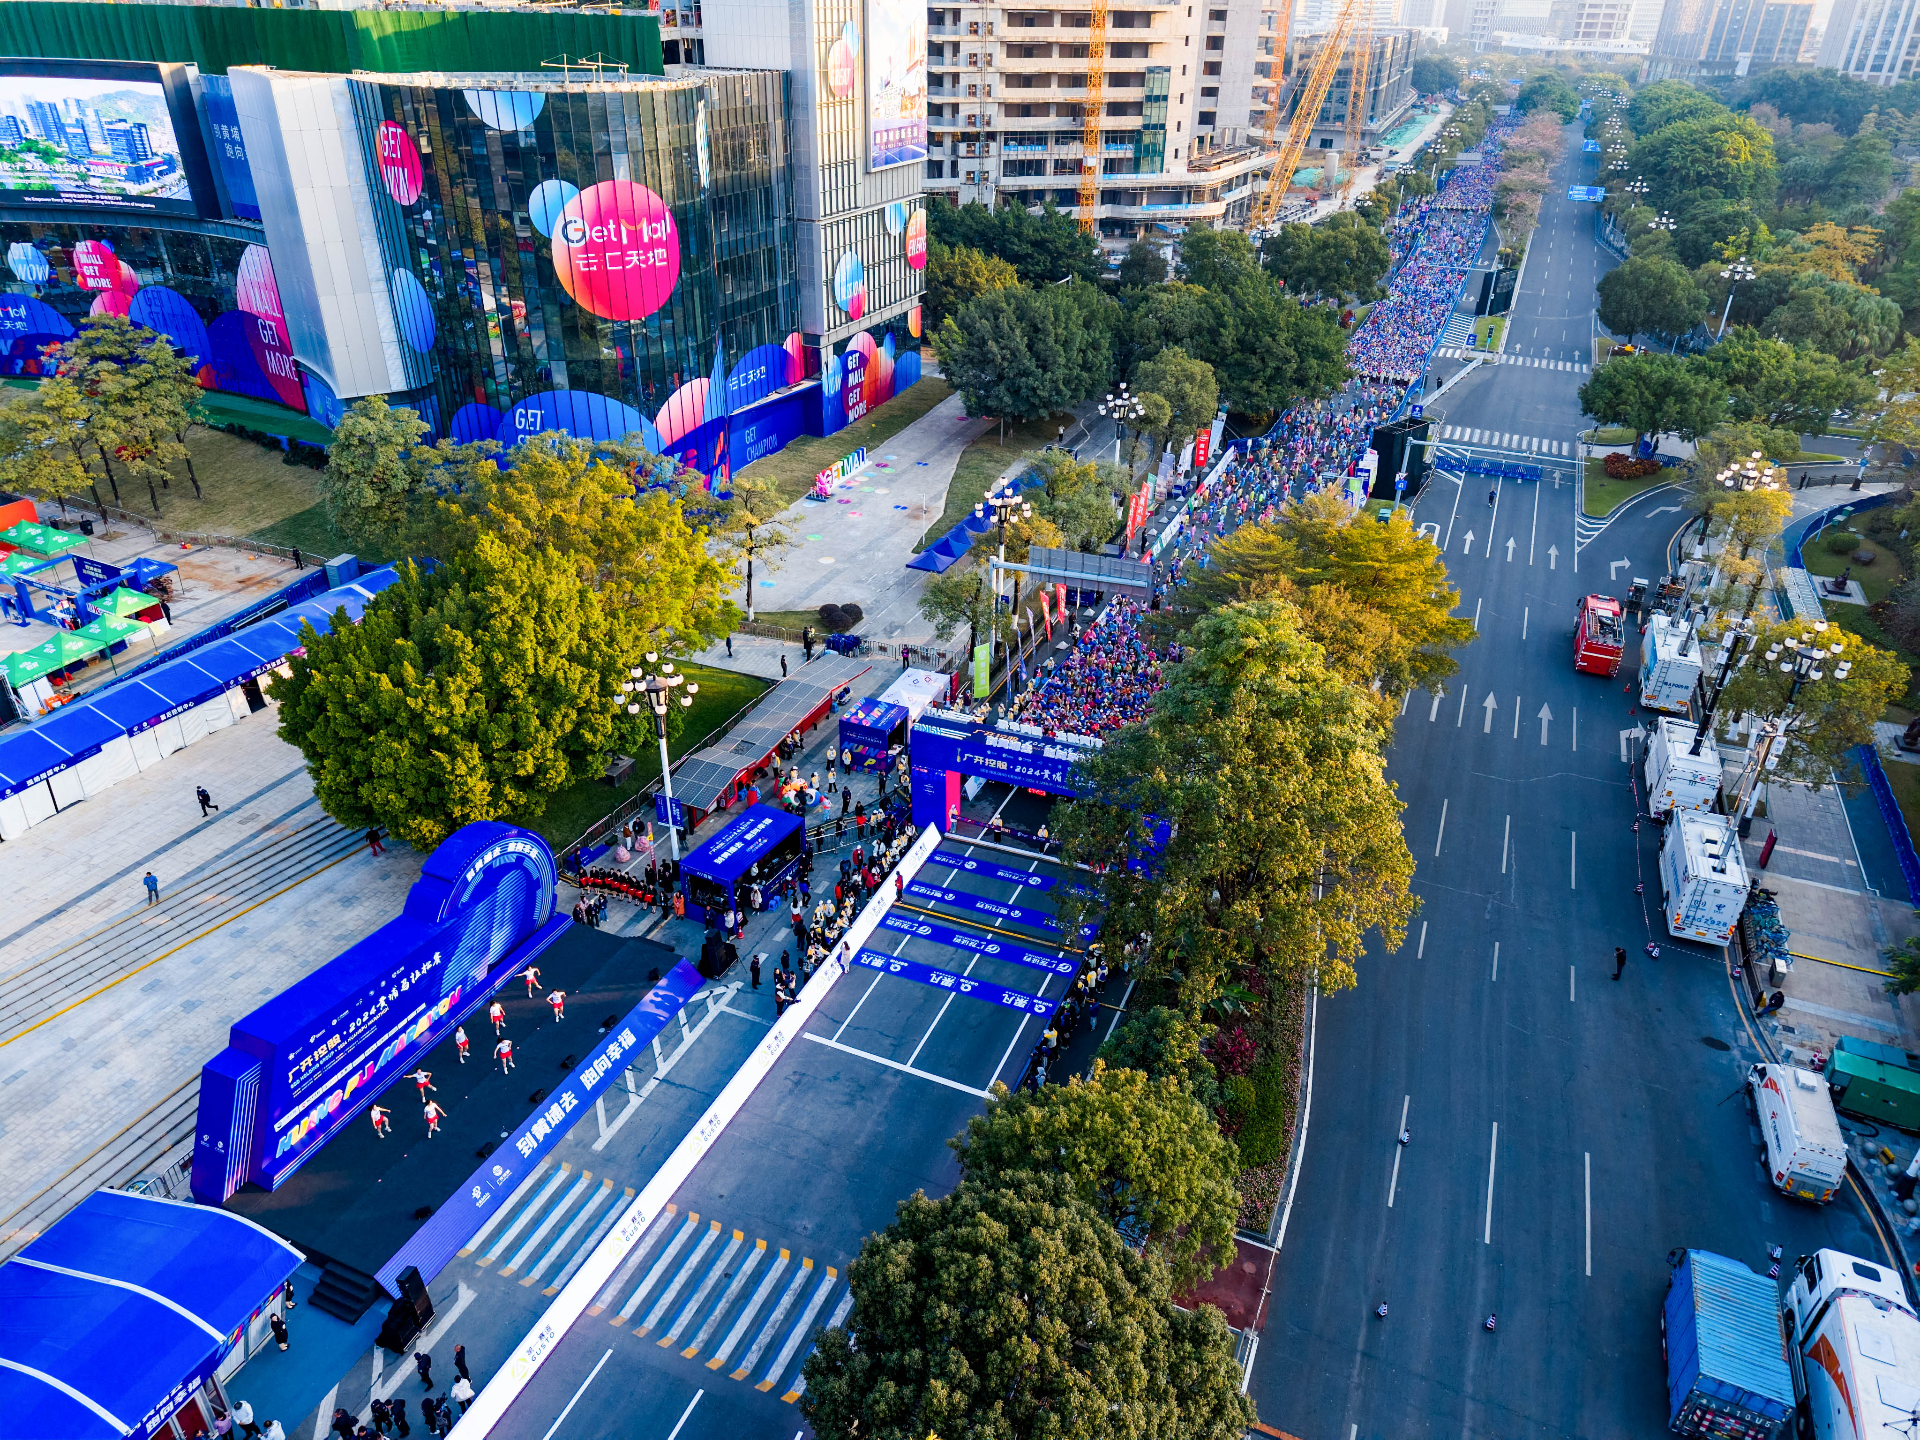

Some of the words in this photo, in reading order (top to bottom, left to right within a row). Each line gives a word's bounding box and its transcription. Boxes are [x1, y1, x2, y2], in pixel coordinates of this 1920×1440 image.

[379, 125, 403, 159] GET
[383, 164, 409, 198] WIN
[75, 241, 92, 253] GET
[575, 247, 667, 271] 云汇天地
[80, 254, 104, 265] MALL
[83, 266, 100, 277] GET
[16, 264, 49, 281] WOW
[87, 278, 113, 289] MORE
[258, 319, 279, 347] GET
[265, 350, 299, 381] MORE
[847, 352, 860, 371] GET
[848, 367, 865, 388] MALL
[848, 387, 861, 406] GET
[515, 408, 544, 431] GET
[848, 400, 867, 424] MORE
[745, 426, 757, 444] GET
[746, 432, 778, 462] CHAMPION
[841, 741, 887, 759] HUANG
[516, 1090, 579, 1159] 到黄埔去
[580, 1027, 637, 1091] 跑向幸福
[703, 1118, 722, 1142] GUSTO
[625, 1216, 646, 1242] GUSTO
[531, 1331, 555, 1362] GUSTO
[145, 1374, 202, 1434] 跑向幸福
